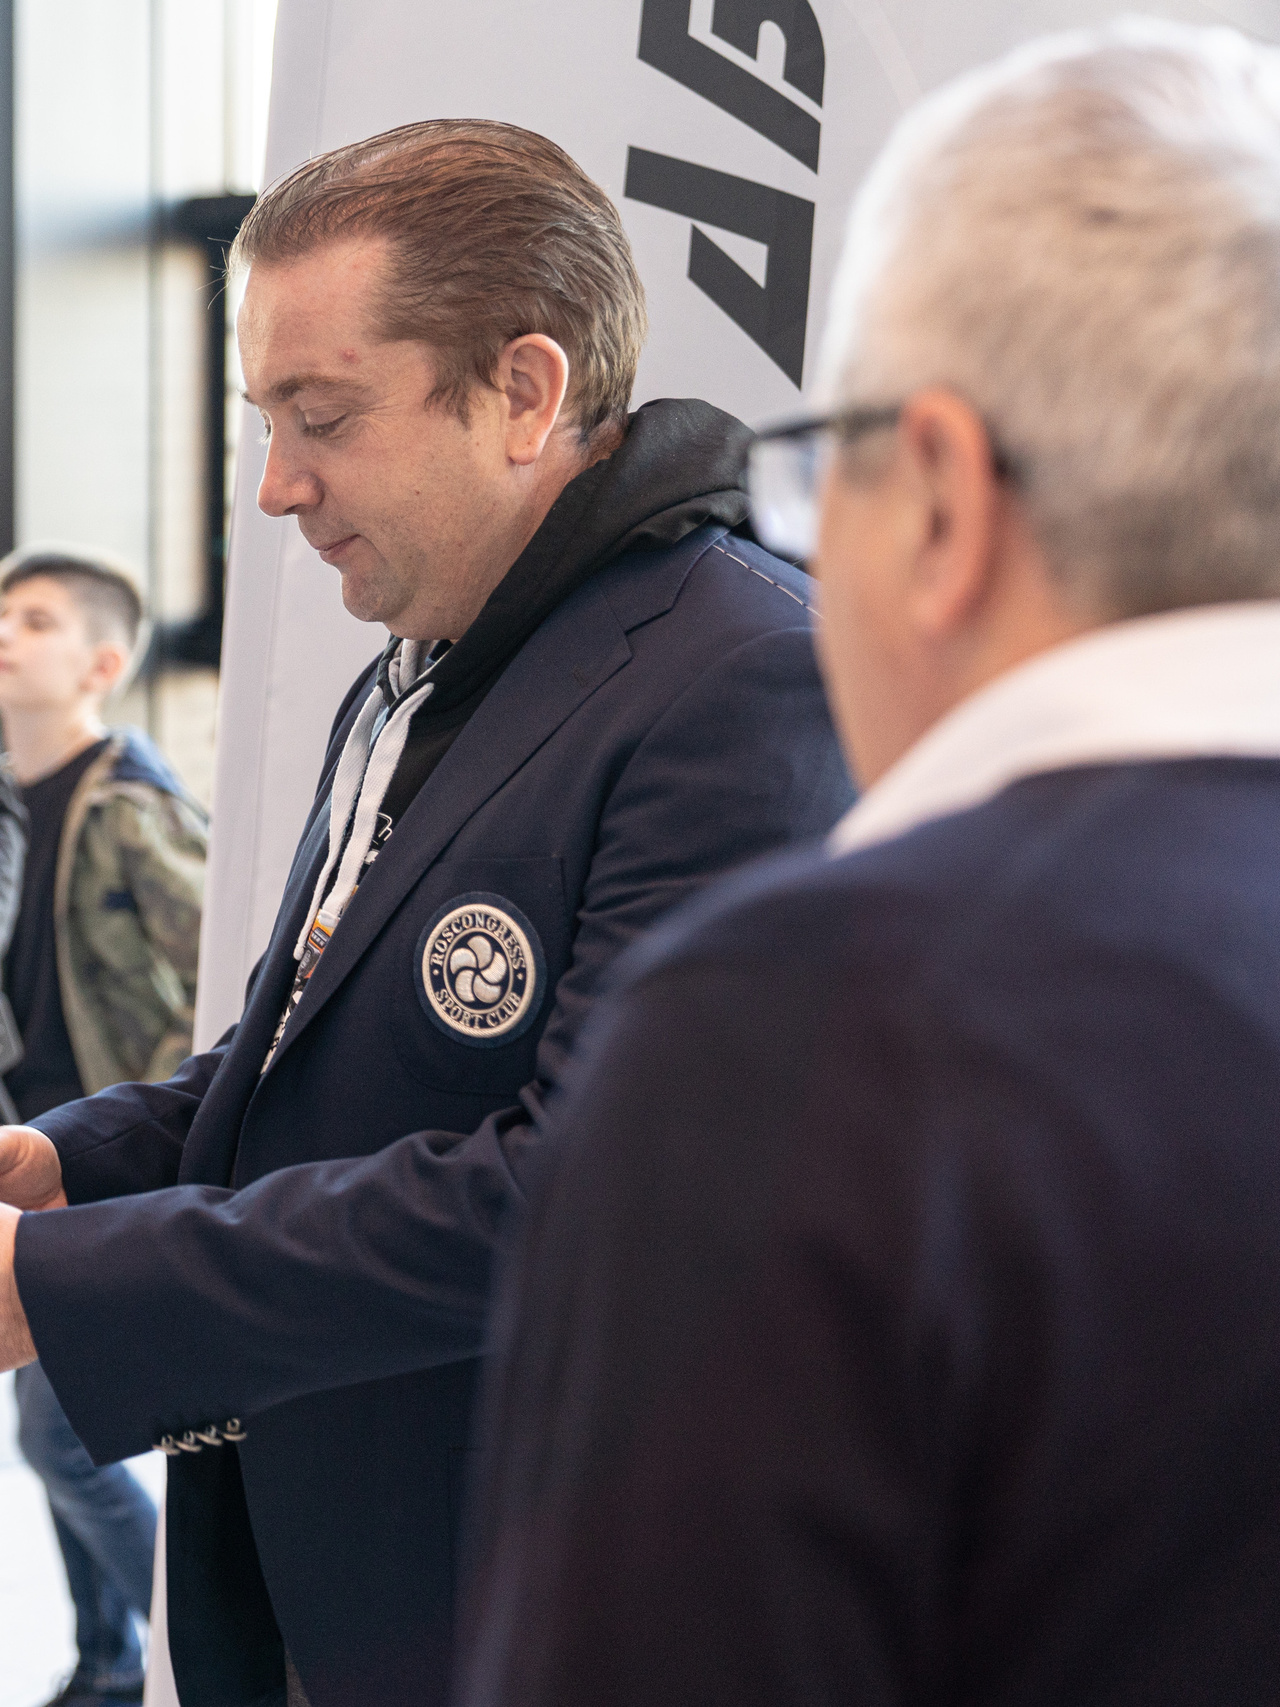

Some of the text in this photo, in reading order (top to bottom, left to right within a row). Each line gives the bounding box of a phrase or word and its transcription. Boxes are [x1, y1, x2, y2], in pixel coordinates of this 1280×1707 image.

[430, 912, 526, 970] ROSCONGRESS
[435, 988, 521, 1029] SPORT CLUB
